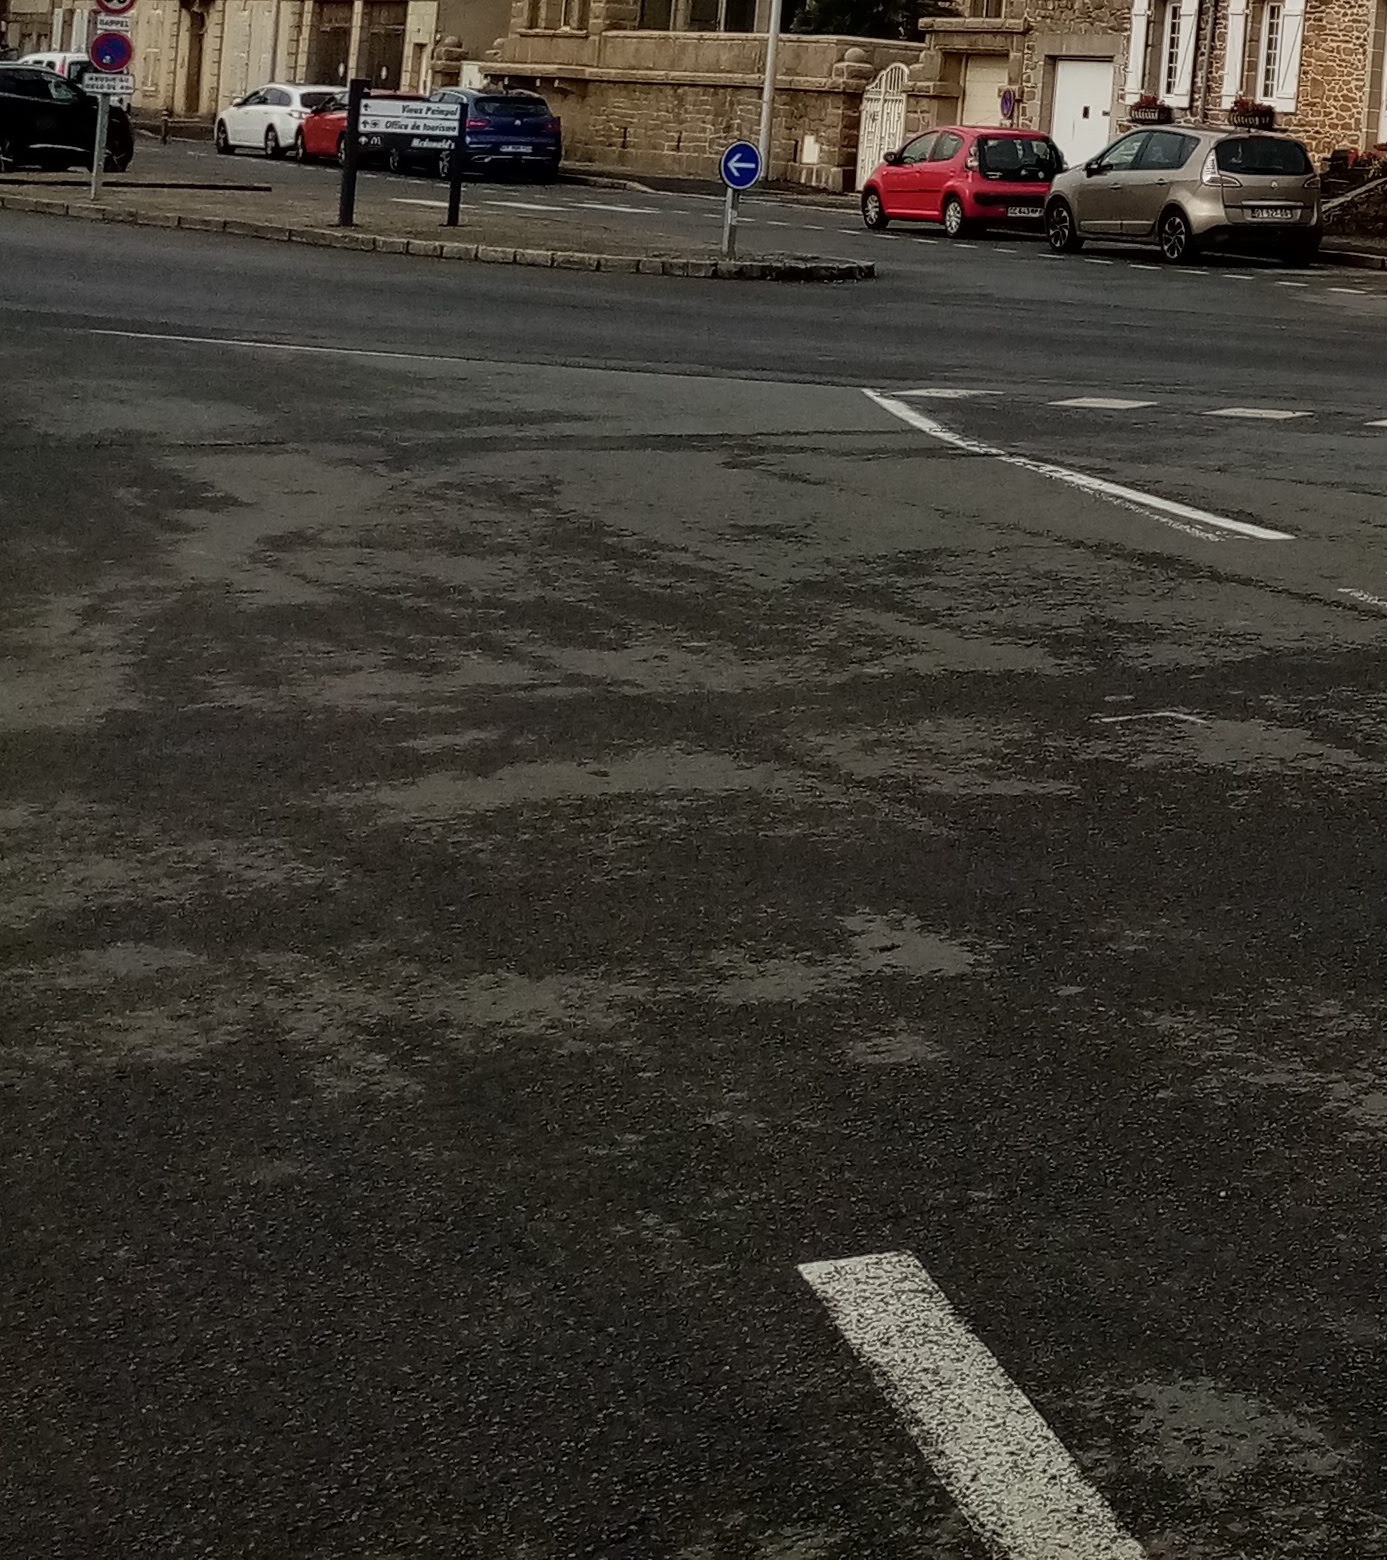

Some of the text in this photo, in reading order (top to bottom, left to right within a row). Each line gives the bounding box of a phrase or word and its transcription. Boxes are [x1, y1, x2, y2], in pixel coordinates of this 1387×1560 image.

[401, 104, 424, 115] Vieux
[385, 121, 457, 133] Office de tourisme
